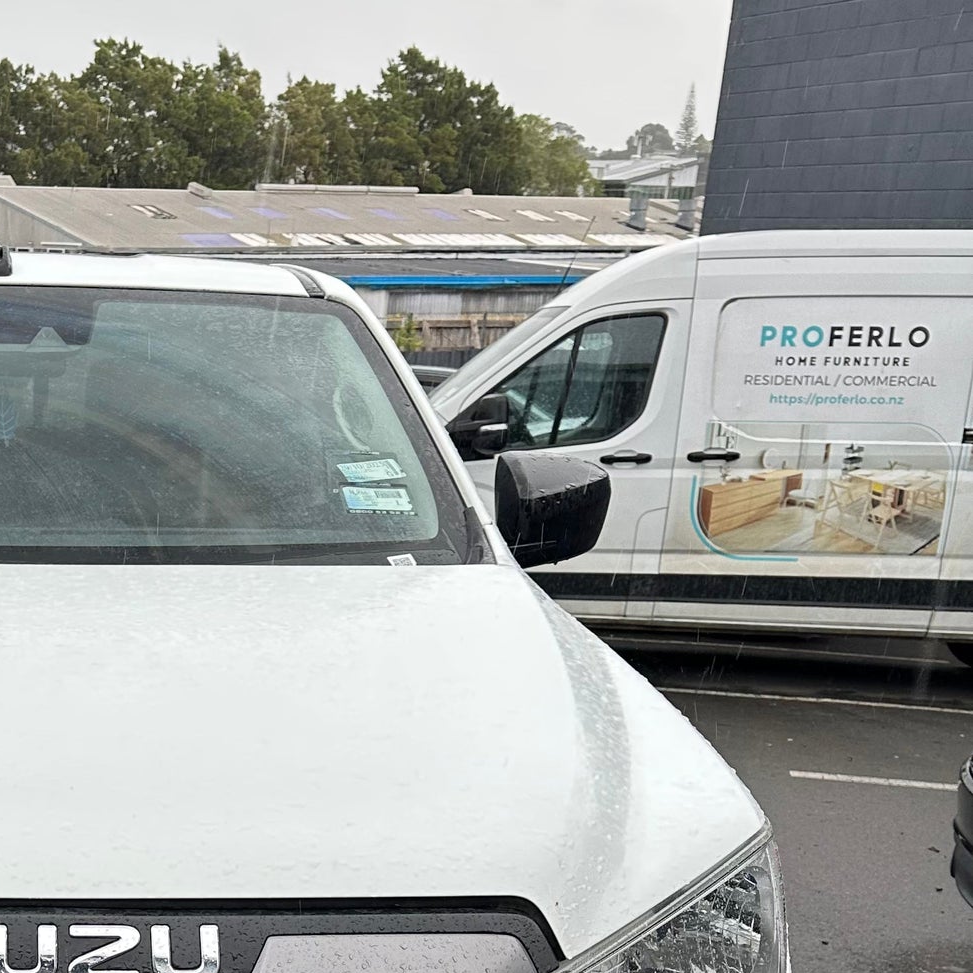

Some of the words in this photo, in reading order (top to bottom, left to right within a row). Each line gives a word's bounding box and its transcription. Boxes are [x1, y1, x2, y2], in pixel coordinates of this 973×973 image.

[760, 325, 931, 348] PROFERLO
[775, 356, 817, 367] HOME
[823, 356, 911, 367] FURNITURE
[744, 374, 831, 386] RESIDENTIAL
[843, 375, 937, 387] COMMERCIAL
[769, 393, 904, 406] https://proferlo.co.nz
